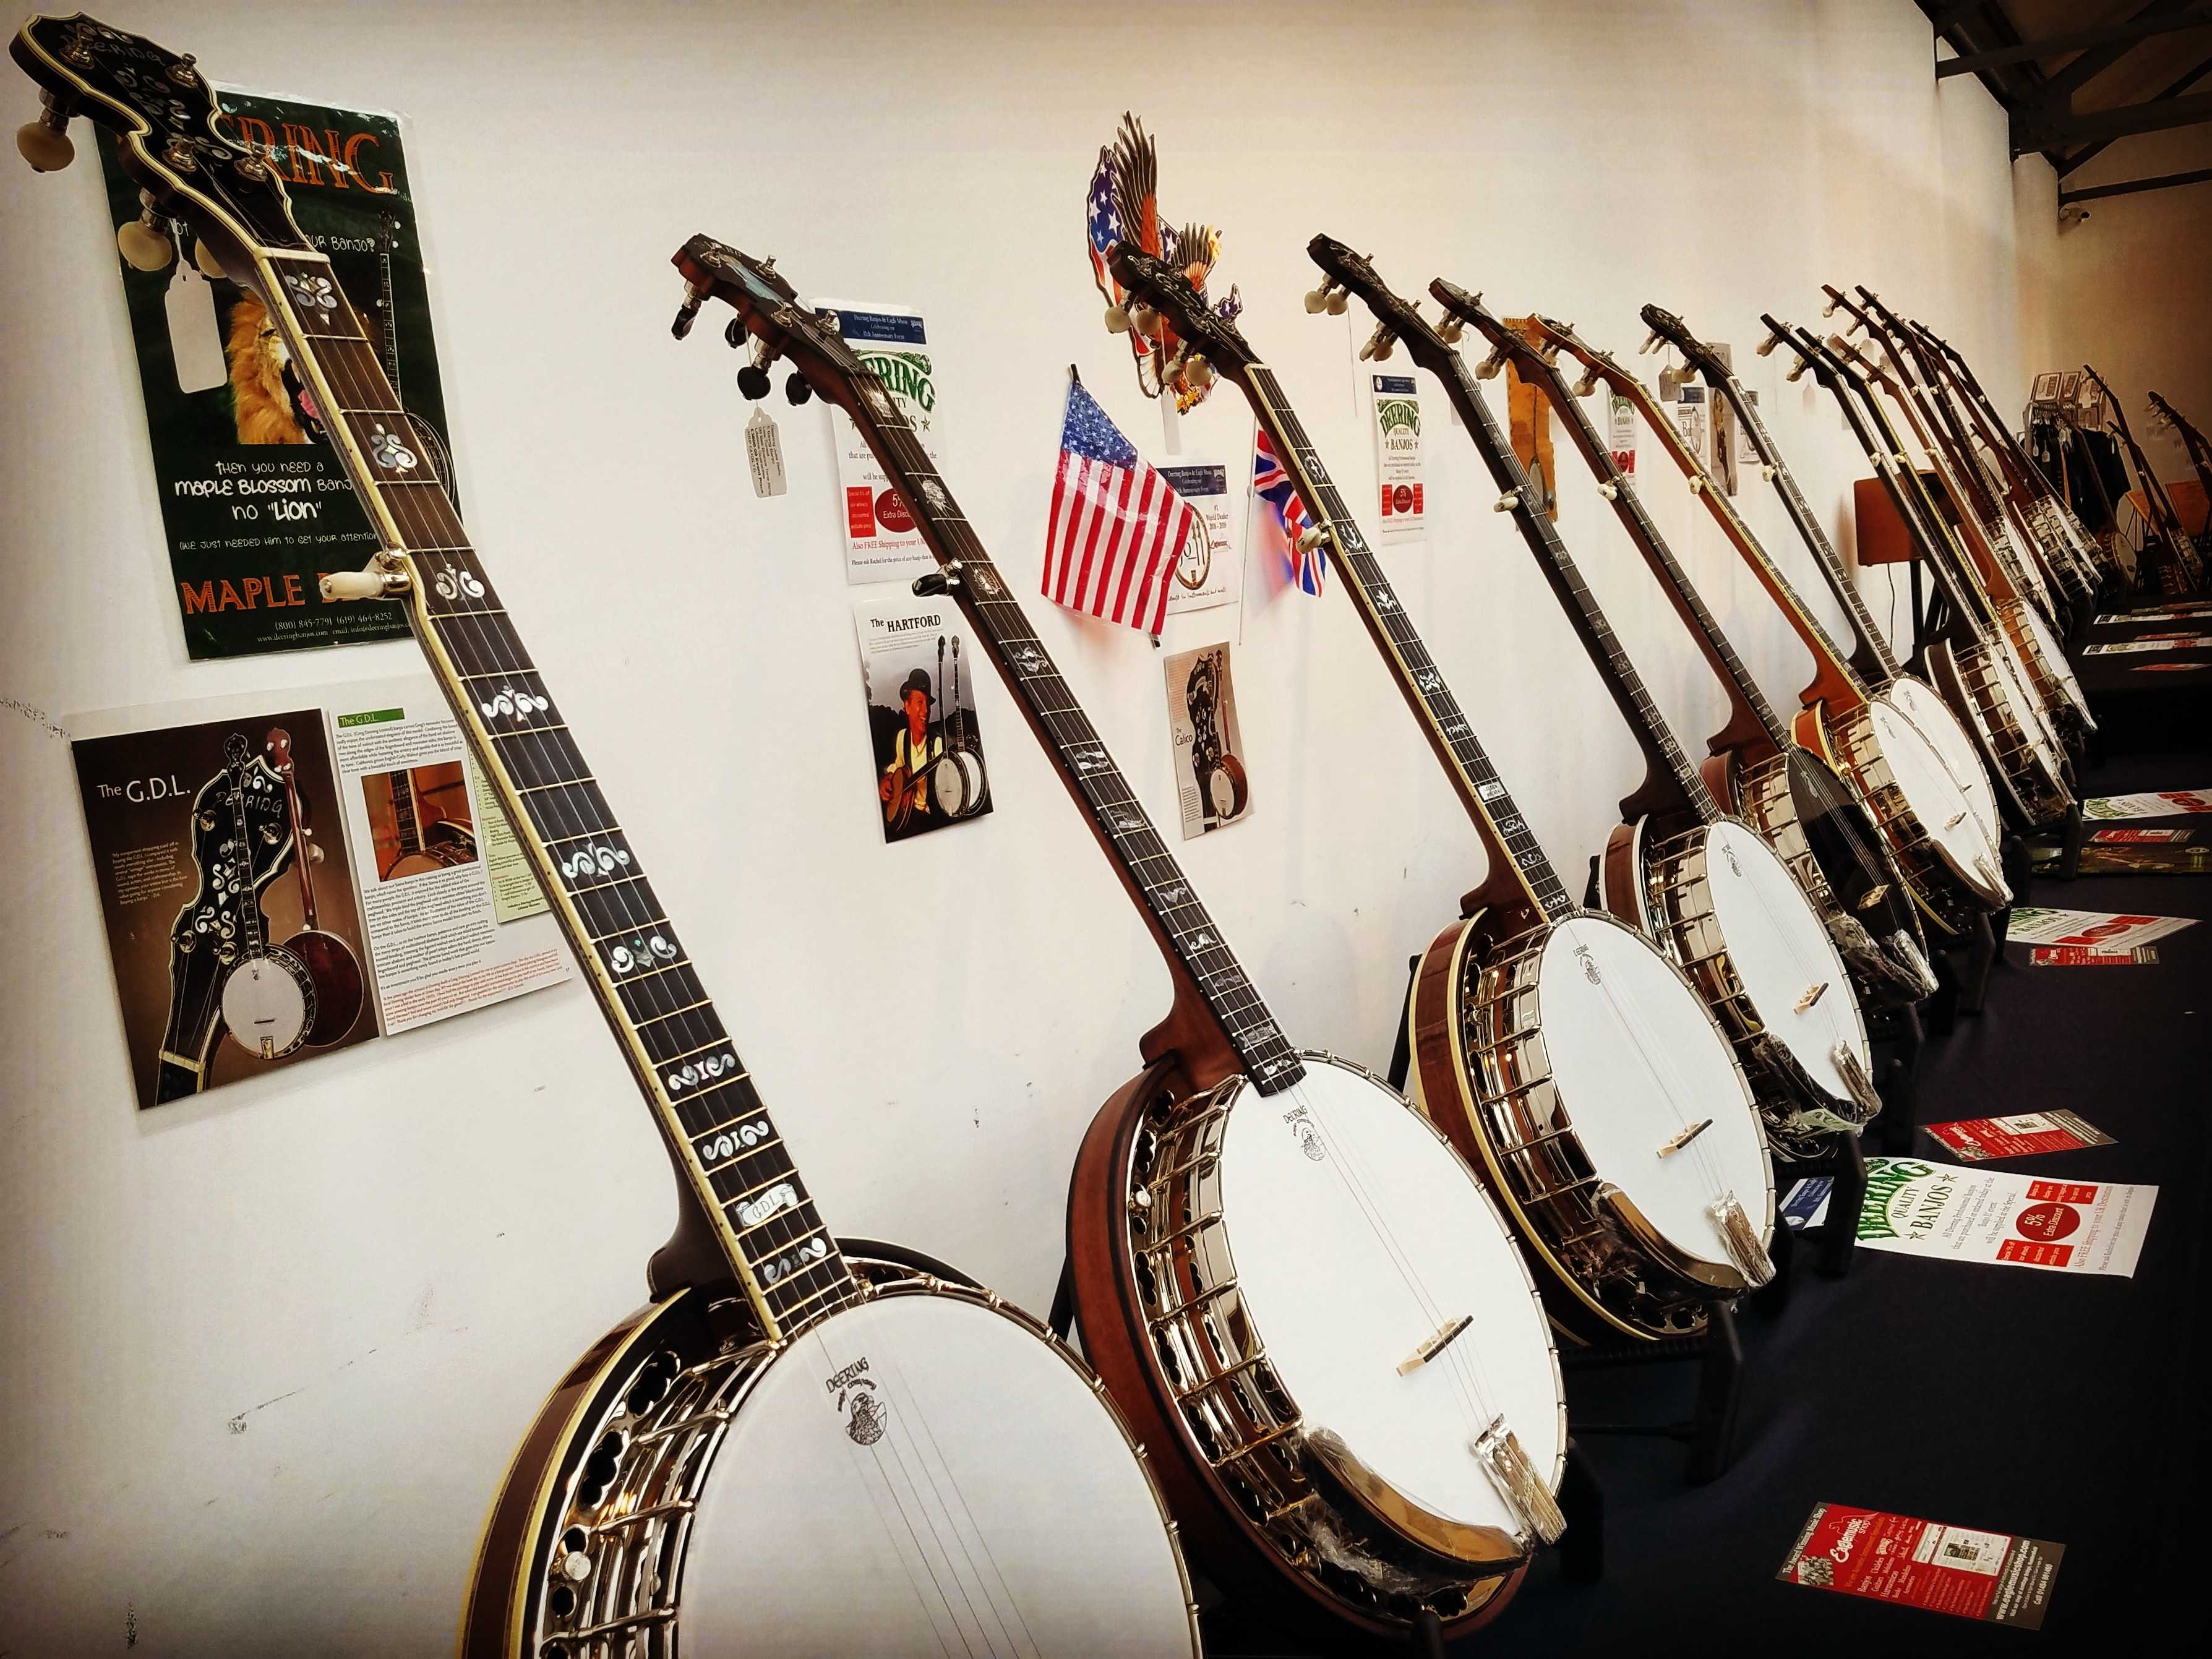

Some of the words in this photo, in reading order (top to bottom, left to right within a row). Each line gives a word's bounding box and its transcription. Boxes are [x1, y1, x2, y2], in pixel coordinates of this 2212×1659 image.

[1379, 403, 1421, 438] DEERING
[1391, 439, 1413, 450] BANJOS
[852, 542, 864, 550] Also
[864, 540, 878, 549] FREE
[878, 539, 899, 551] Shipping
[180, 574, 305, 614] MAPLE
[275, 620, 296, 631] (800)
[299, 617, 332, 629] 845-7791
[337, 615, 356, 625] (619)
[358, 612, 393, 624] 464-8252
[870, 617, 885, 628] The
[887, 614, 941, 632] HARTFORD
[340, 717, 354, 726] The
[1175, 732, 1193, 746] Calico
[97, 784, 122, 798] The
[126, 775, 191, 802] G.D.L.
[1891, 1186, 1919, 1219] QUALITY
[1910, 1184, 1953, 1230] BANJOS
[2025, 1214, 2044, 1225] 5%
[2048, 1207, 2063, 1225] Discount
[2043, 1225, 2056, 1236] Extra
[826, 1357, 870, 1394] DEERING
[1782, 1564, 1794, 1573] The
[1788, 1550, 1801, 1564] Award
[1796, 1532, 1814, 1549] Winning
[1806, 1519, 1819, 1531] Music
[1813, 1508, 1826, 1519] Shop
[1829, 1518, 1863, 1563] Eaglemusic
[1857, 1575, 1871, 1592] Banjos
